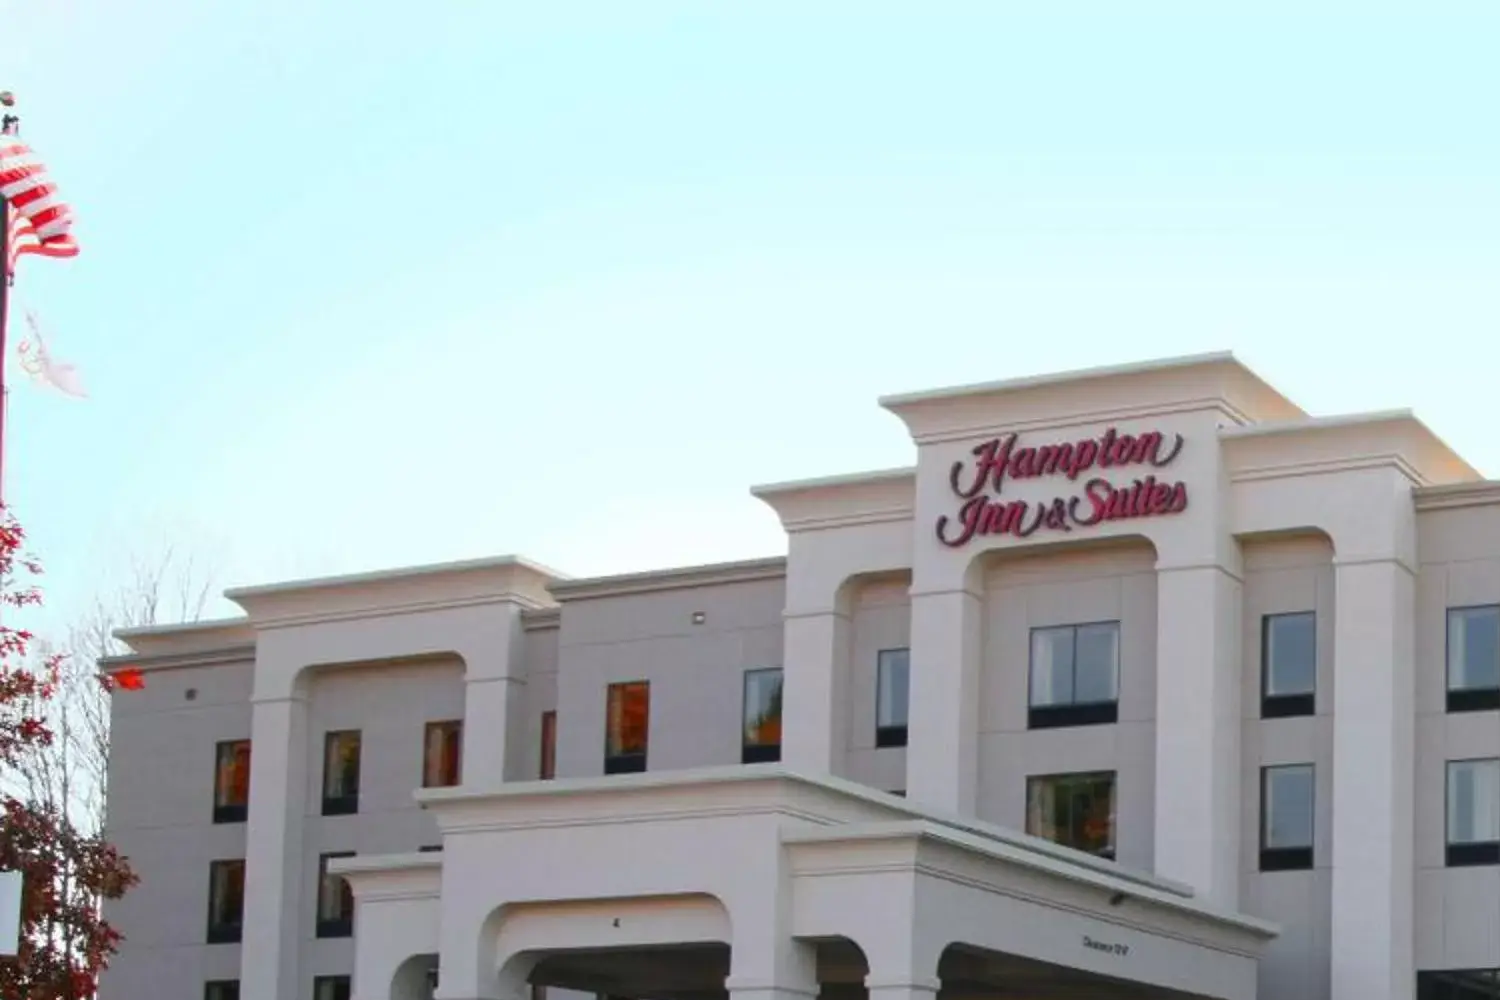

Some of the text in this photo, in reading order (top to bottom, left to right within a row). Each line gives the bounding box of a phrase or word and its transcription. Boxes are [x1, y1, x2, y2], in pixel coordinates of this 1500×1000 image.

[950, 428, 1184, 498] Hampton
[936, 475, 1189, 547] Inn & Suites
